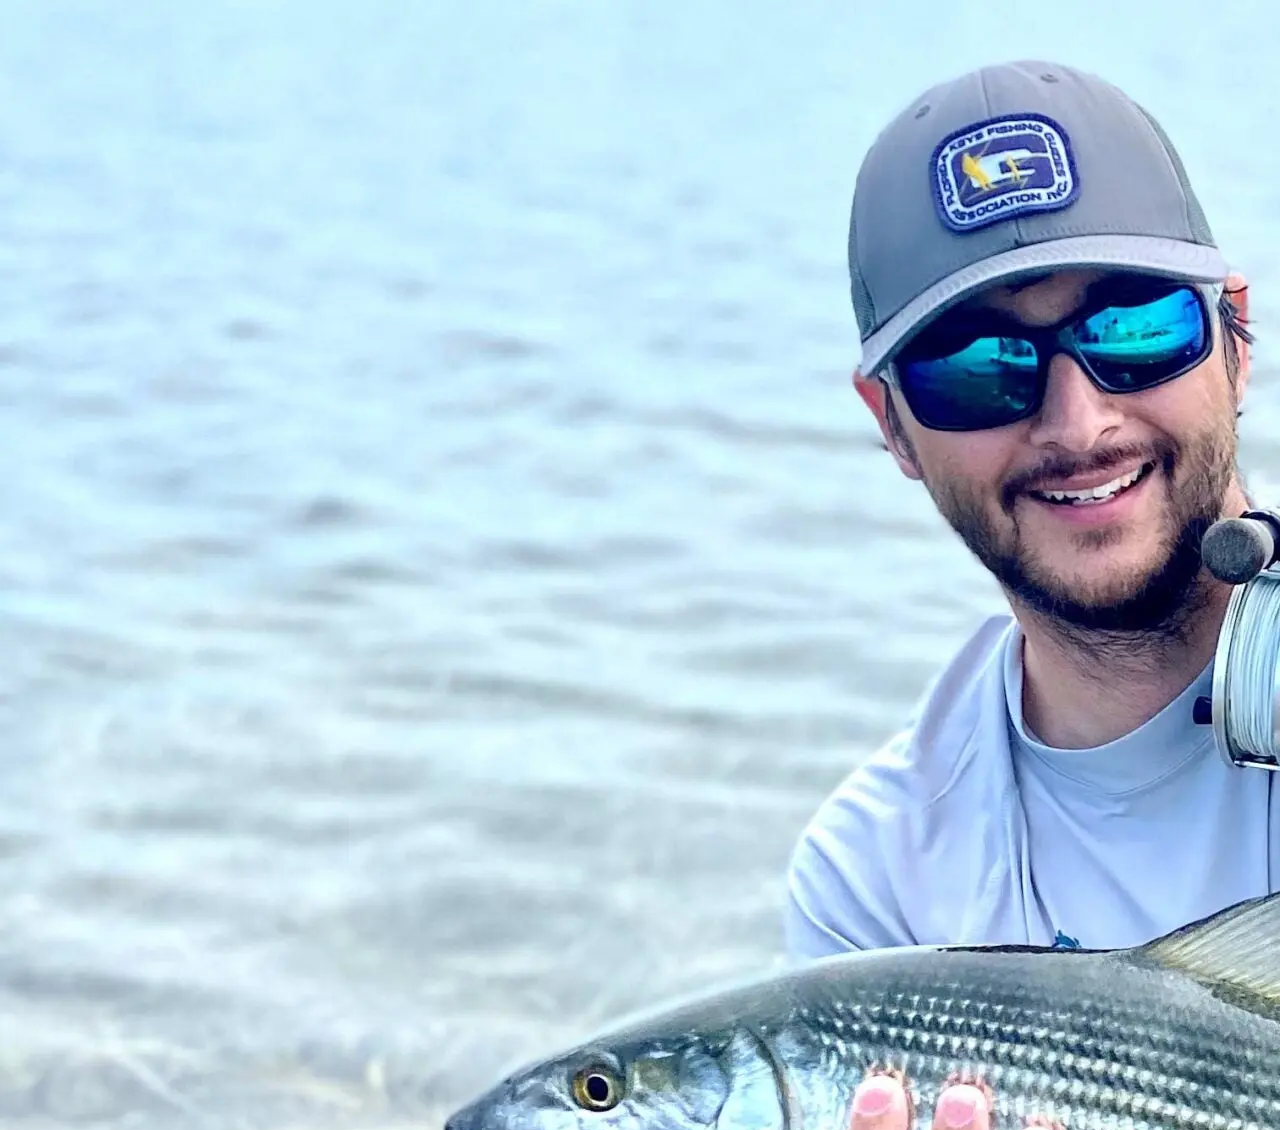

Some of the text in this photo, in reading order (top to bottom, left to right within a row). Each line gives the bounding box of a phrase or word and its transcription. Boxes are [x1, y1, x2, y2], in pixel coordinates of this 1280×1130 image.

[949, 132, 984, 151] KEYS
[987, 123, 1043, 135] FISHING
[1044, 133, 1066, 177] GUIDES
[952, 192, 1041, 221] ASSOCIATION
